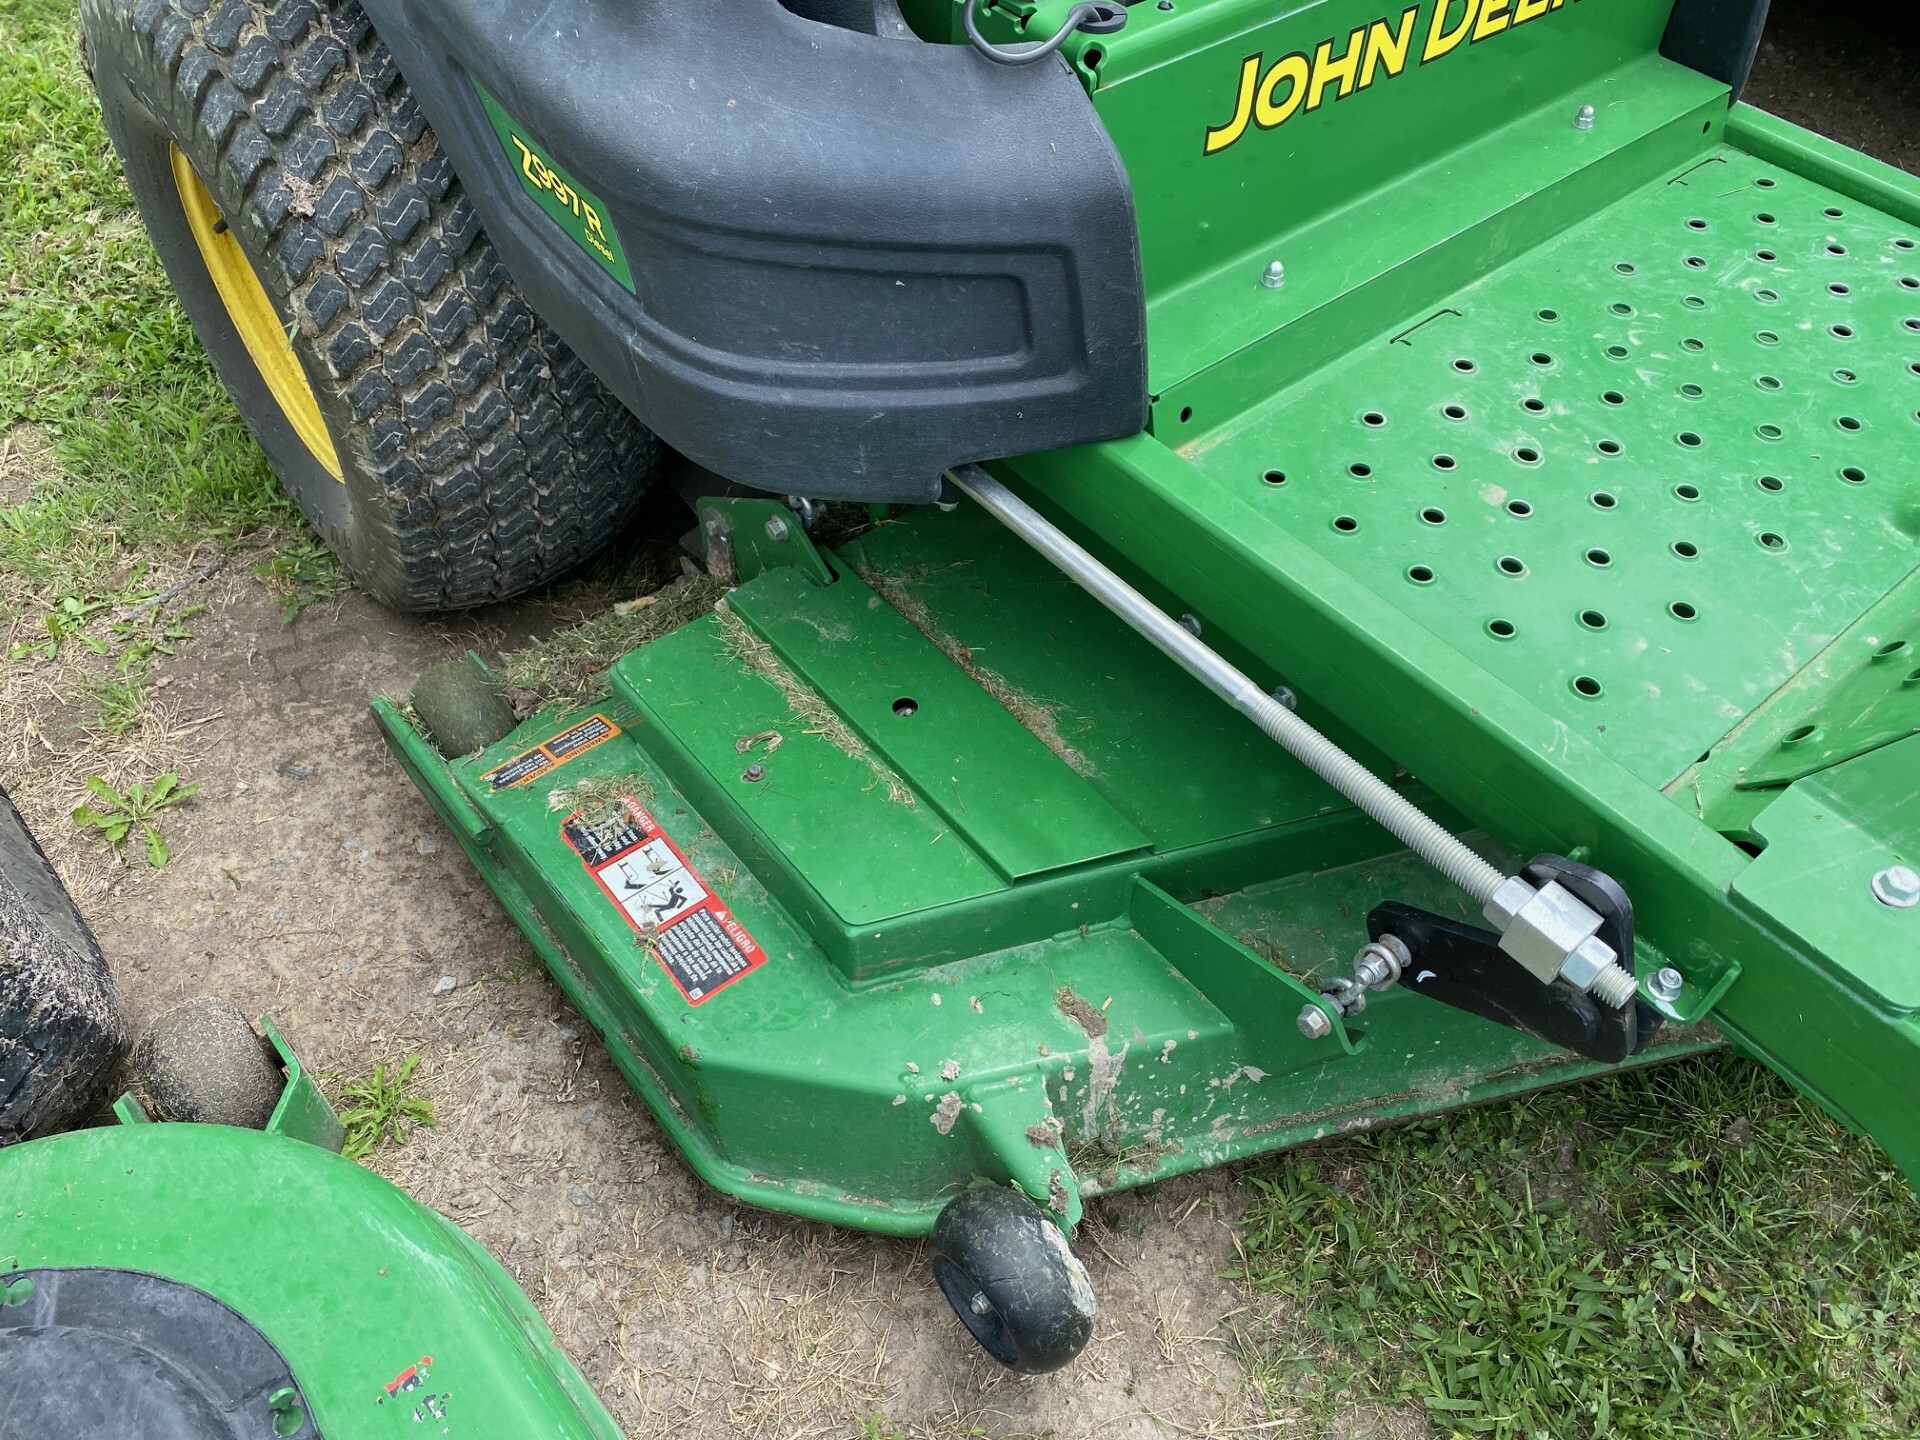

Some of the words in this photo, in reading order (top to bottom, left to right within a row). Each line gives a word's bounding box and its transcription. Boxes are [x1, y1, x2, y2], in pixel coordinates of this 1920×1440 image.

[1203, 5, 1420, 156] JOHN
[1420, 0, 1582, 66] DE
[584, 227, 616, 264] Diesel
[565, 738, 603, 759] WARNING
[628, 801, 656, 832] DANGER
[723, 918, 756, 954] PELIGRO
